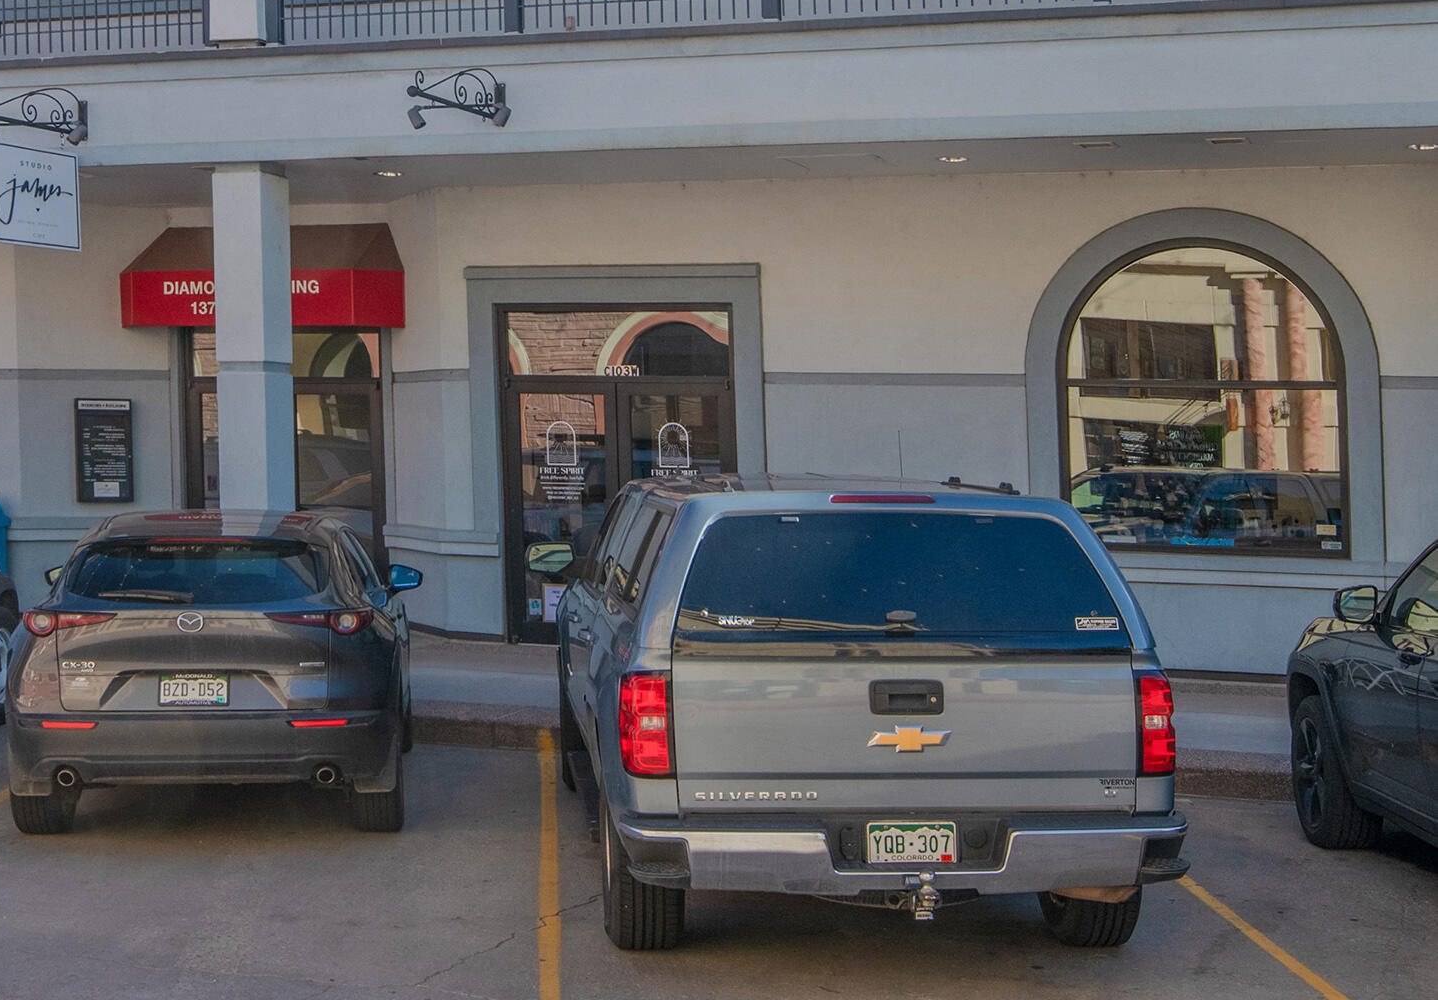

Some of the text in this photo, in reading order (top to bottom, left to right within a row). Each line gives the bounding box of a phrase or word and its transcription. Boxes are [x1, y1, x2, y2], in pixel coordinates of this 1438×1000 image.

[19, 160, 53, 171] STUDIO
[163, 279, 320, 296] DIAMO ING
[539, 467, 586, 475] FREE SPIRIT
[1099, 778, 1135, 786] RIVERTON
[695, 791, 818, 801] SILVERADO
